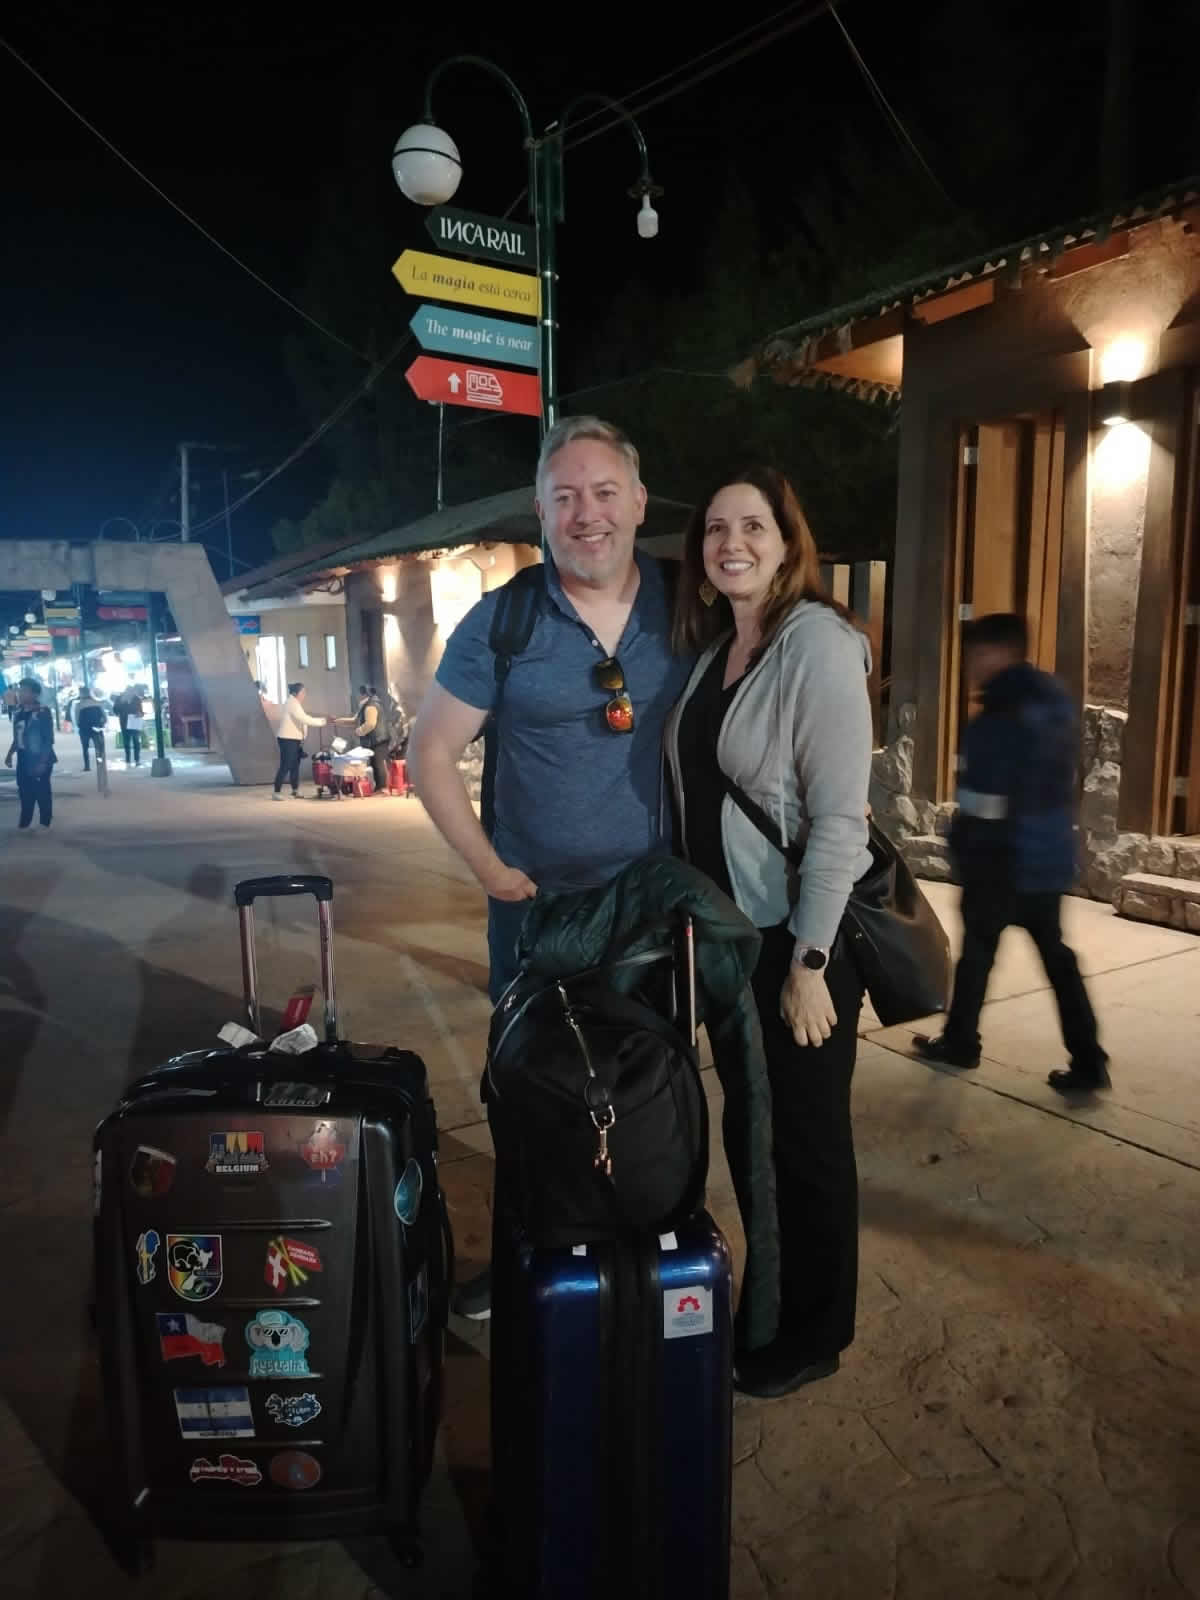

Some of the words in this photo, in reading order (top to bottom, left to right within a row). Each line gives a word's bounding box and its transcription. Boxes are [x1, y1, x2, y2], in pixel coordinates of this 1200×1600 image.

[411, 264, 428, 281] La
[432, 273, 476, 294] magia
[503, 287, 532, 302] cerca
[425, 319, 449, 337] The
[452, 326, 494, 345] magic
[496, 332, 506, 346] is
[507, 338, 535, 352] near
[215, 1164, 260, 1174] BELGIUM
